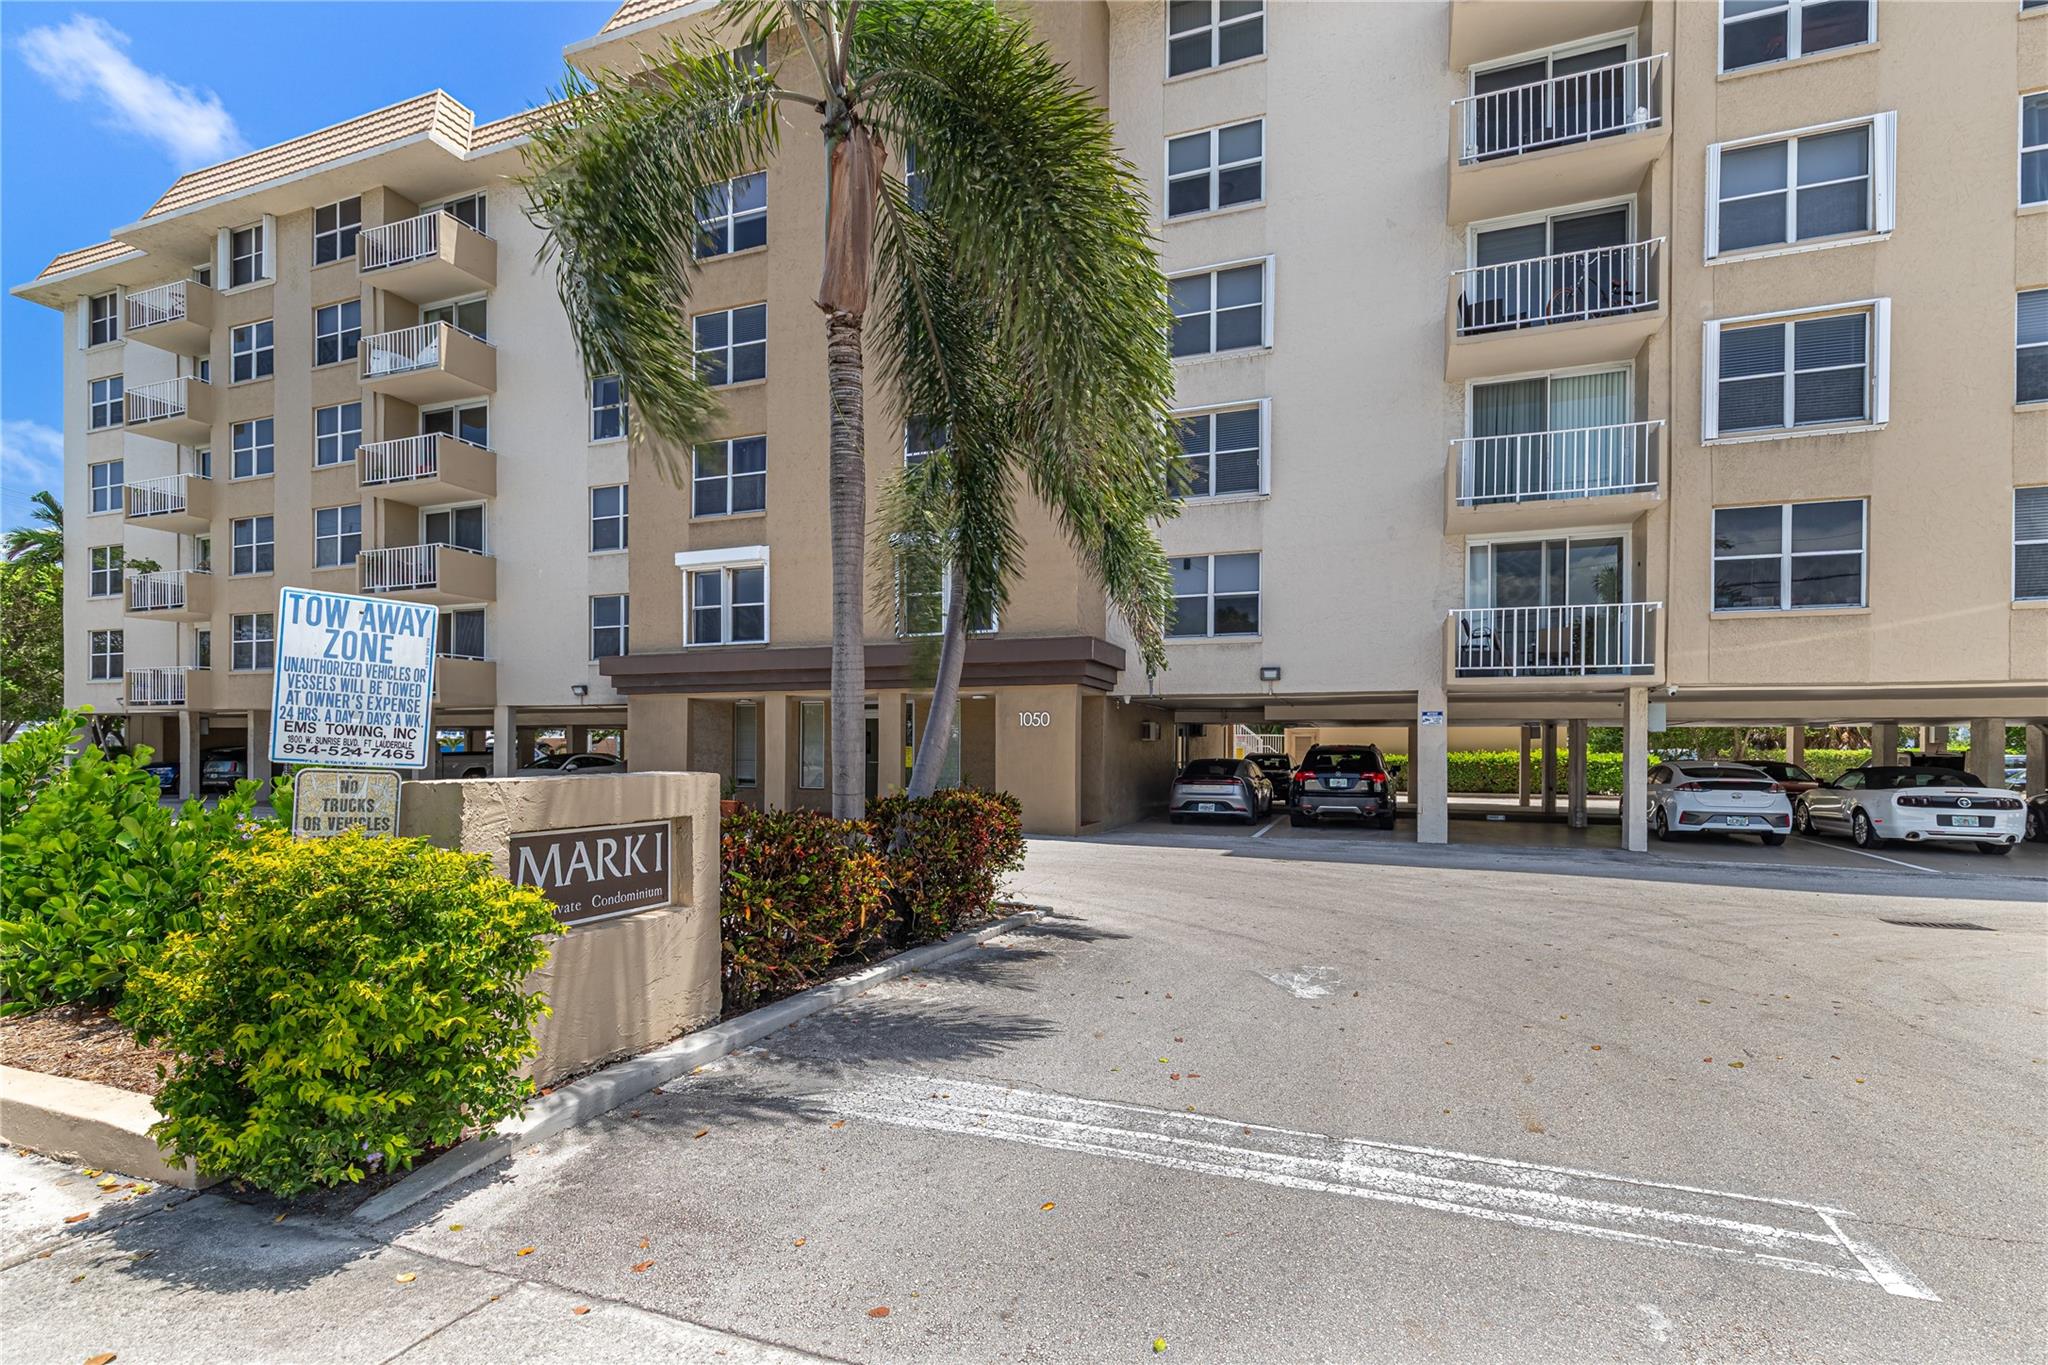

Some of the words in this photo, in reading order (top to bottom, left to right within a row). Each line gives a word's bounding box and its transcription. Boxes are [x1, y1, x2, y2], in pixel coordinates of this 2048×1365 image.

[289, 593, 350, 629] TOW
[360, 603, 431, 637] AWAY
[323, 629, 394, 664] ZONE
[284, 656, 362, 677] UNAUTHORIZED
[366, 664, 411, 681] VEHICLES
[414, 668, 426, 683] OR
[288, 673, 336, 691] VESSELS
[340, 678, 365, 694] WILL
[370, 680, 383, 695] BE
[387, 681, 422, 698] TOWED
[286, 690, 301, 705] AT
[305, 691, 363, 710] OWNER'S
[367, 695, 421, 713] EXPENSE
[280, 706, 293, 720] 24
[297, 707, 320, 722] HRS.
[324, 709, 331, 722] A
[335, 710, 355, 723] DAY
[358, 711, 364, 724] 7
[367, 712, 391, 726] DAYS
[394, 713, 401, 727] A
[405, 714, 424, 728] WK.
[1018, 711, 1050, 727] 1050
[284, 721, 317, 734] EMS
[325, 723, 386, 739] TOWING,
[394, 727, 417, 740] INC
[283, 743, 415, 760] 954-524-7465
[287, 735, 302, 743] 1800
[315, 736, 341, 745] SUNRISE
[364, 739, 372, 747] FT
[375, 740, 413, 749] LAUDERDALE
[340, 780, 358, 794] NO
[322, 798, 375, 812] TRUCKS
[303, 816, 321, 831] OR
[517, 834, 648, 889] MARK
[655, 832, 663, 872] I
[591, 887, 663, 908] Condominium
